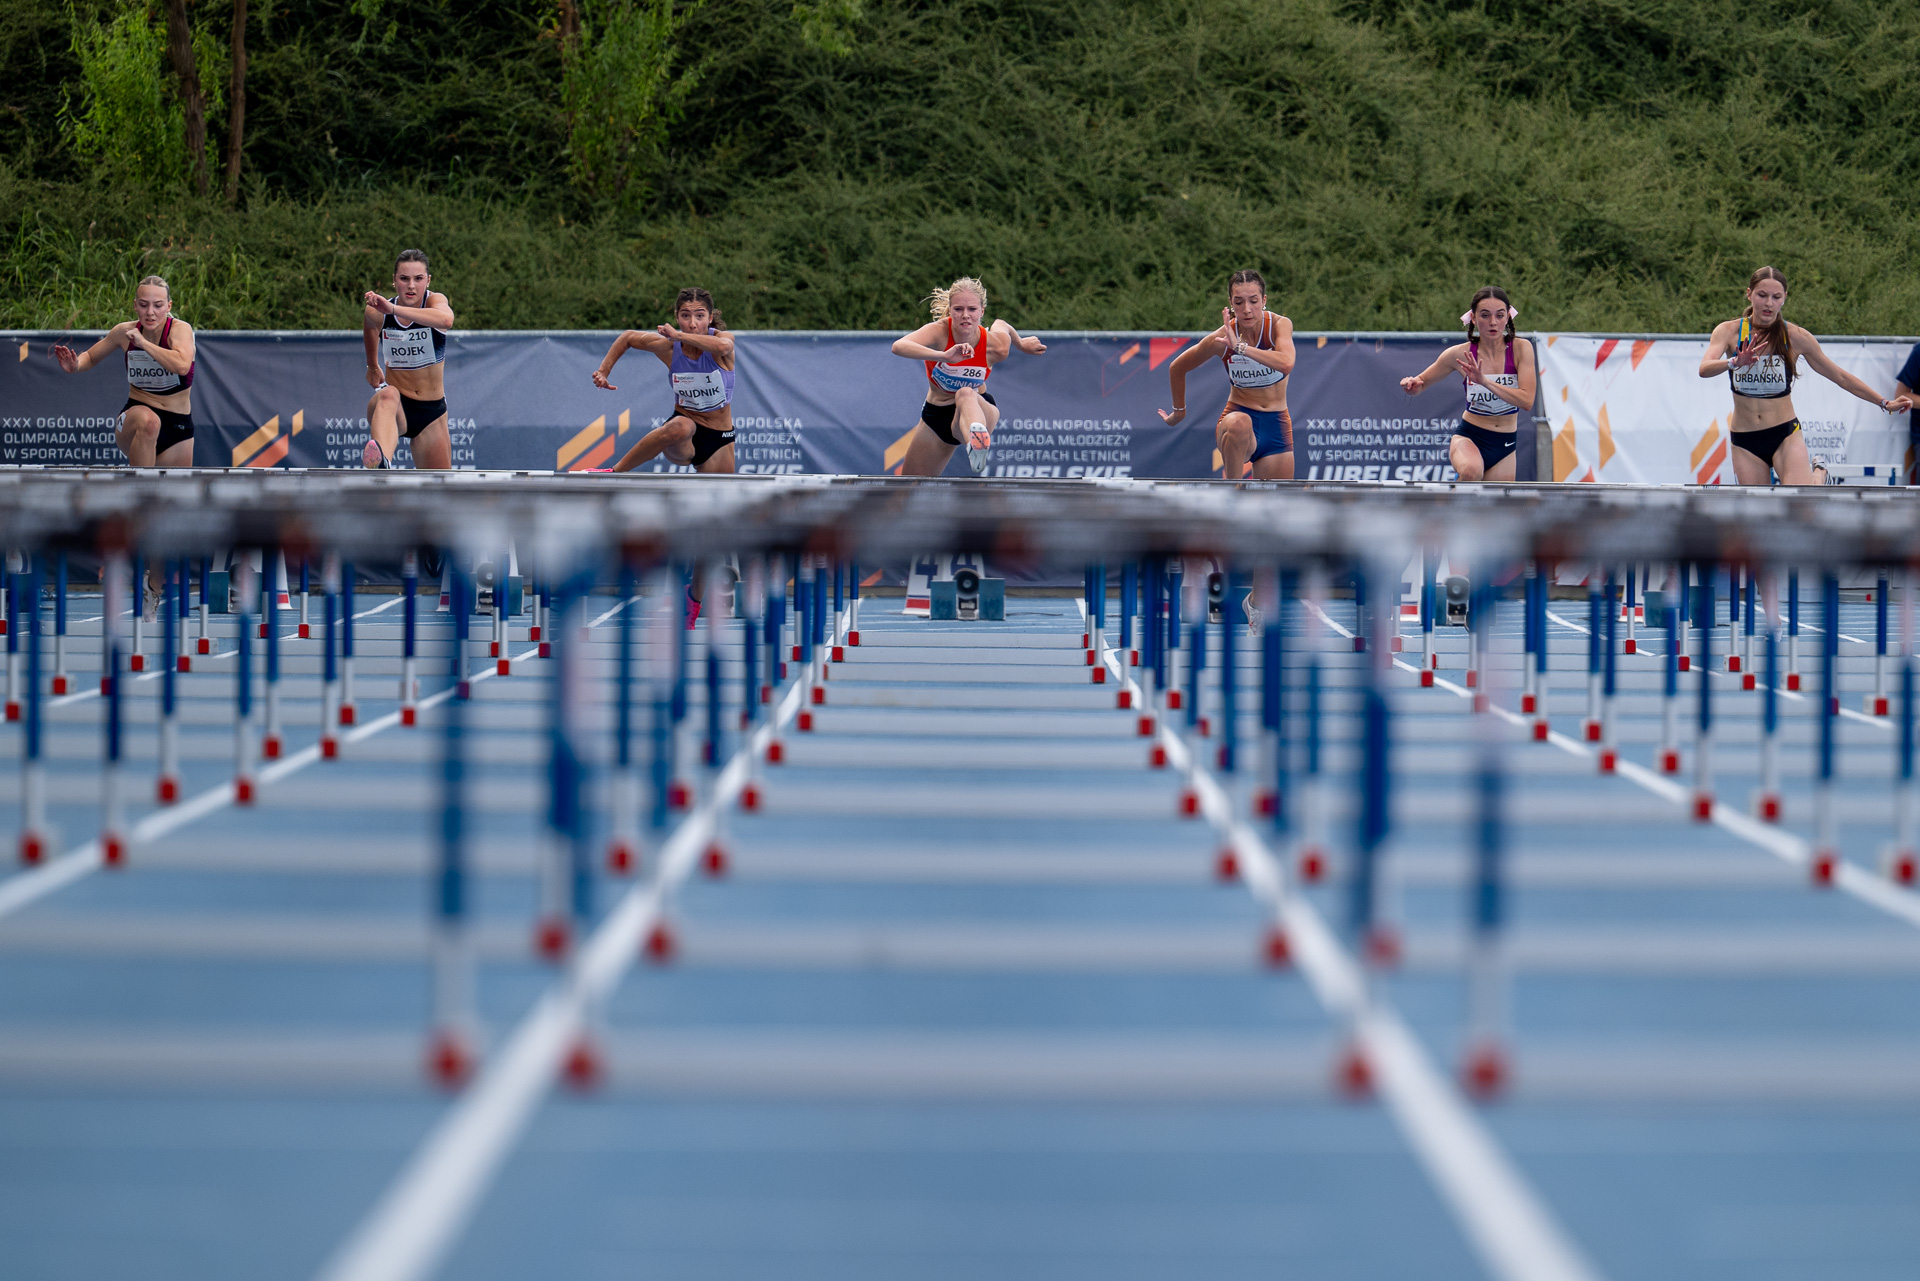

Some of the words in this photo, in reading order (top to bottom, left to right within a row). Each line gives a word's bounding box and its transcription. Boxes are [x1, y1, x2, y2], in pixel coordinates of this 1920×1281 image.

[408, 331, 428, 341] 210
[391, 346, 425, 356] ROJEK
[962, 368, 981, 377] 286
[1231, 367, 1276, 379] MICHALU
[1735, 372, 1784, 383] URBAŃSKA
[705, 375, 712, 383] 1
[1495, 376, 1514, 386] 415
[679, 386, 720, 398] RUDNIK
[1470, 393, 1501, 402] ZAUC
[3, 417, 31, 429] XXX
[36, 416, 115, 429] OGÓLNOPO
[325, 418, 354, 429] XXX
[732, 416, 803, 429] OPOLSKA
[1012, 417, 1132, 430] OGÓLNOPOLSKA
[1306, 418, 1337, 430] XXX
[1340, 416, 1459, 430] OGÓLNOPOLSKA
[1801, 421, 1846, 432] OPOLSKA
[4, 433, 76, 444] OLIMPIADA
[990, 434, 1055, 446] LIMPIADA
[1058, 432, 1131, 446] MŁODZIEŻY
[1308, 434, 1383, 446] OLIMPIADA
[1386, 432, 1452, 446] MŁODZIEŻ
[4, 448, 17, 459] W
[20, 448, 91, 459] SPORTACH
[95, 448, 128, 459] LETN
[326, 449, 339, 460] W
[745, 448, 801, 460] LETNICH
[996, 450, 1069, 462] SPORTACH
[1073, 450, 1131, 462] LETNICH
[1308, 450, 1322, 462] W
[1325, 450, 1398, 462] SPORTACH
[1401, 450, 1451, 462] LETNIC
